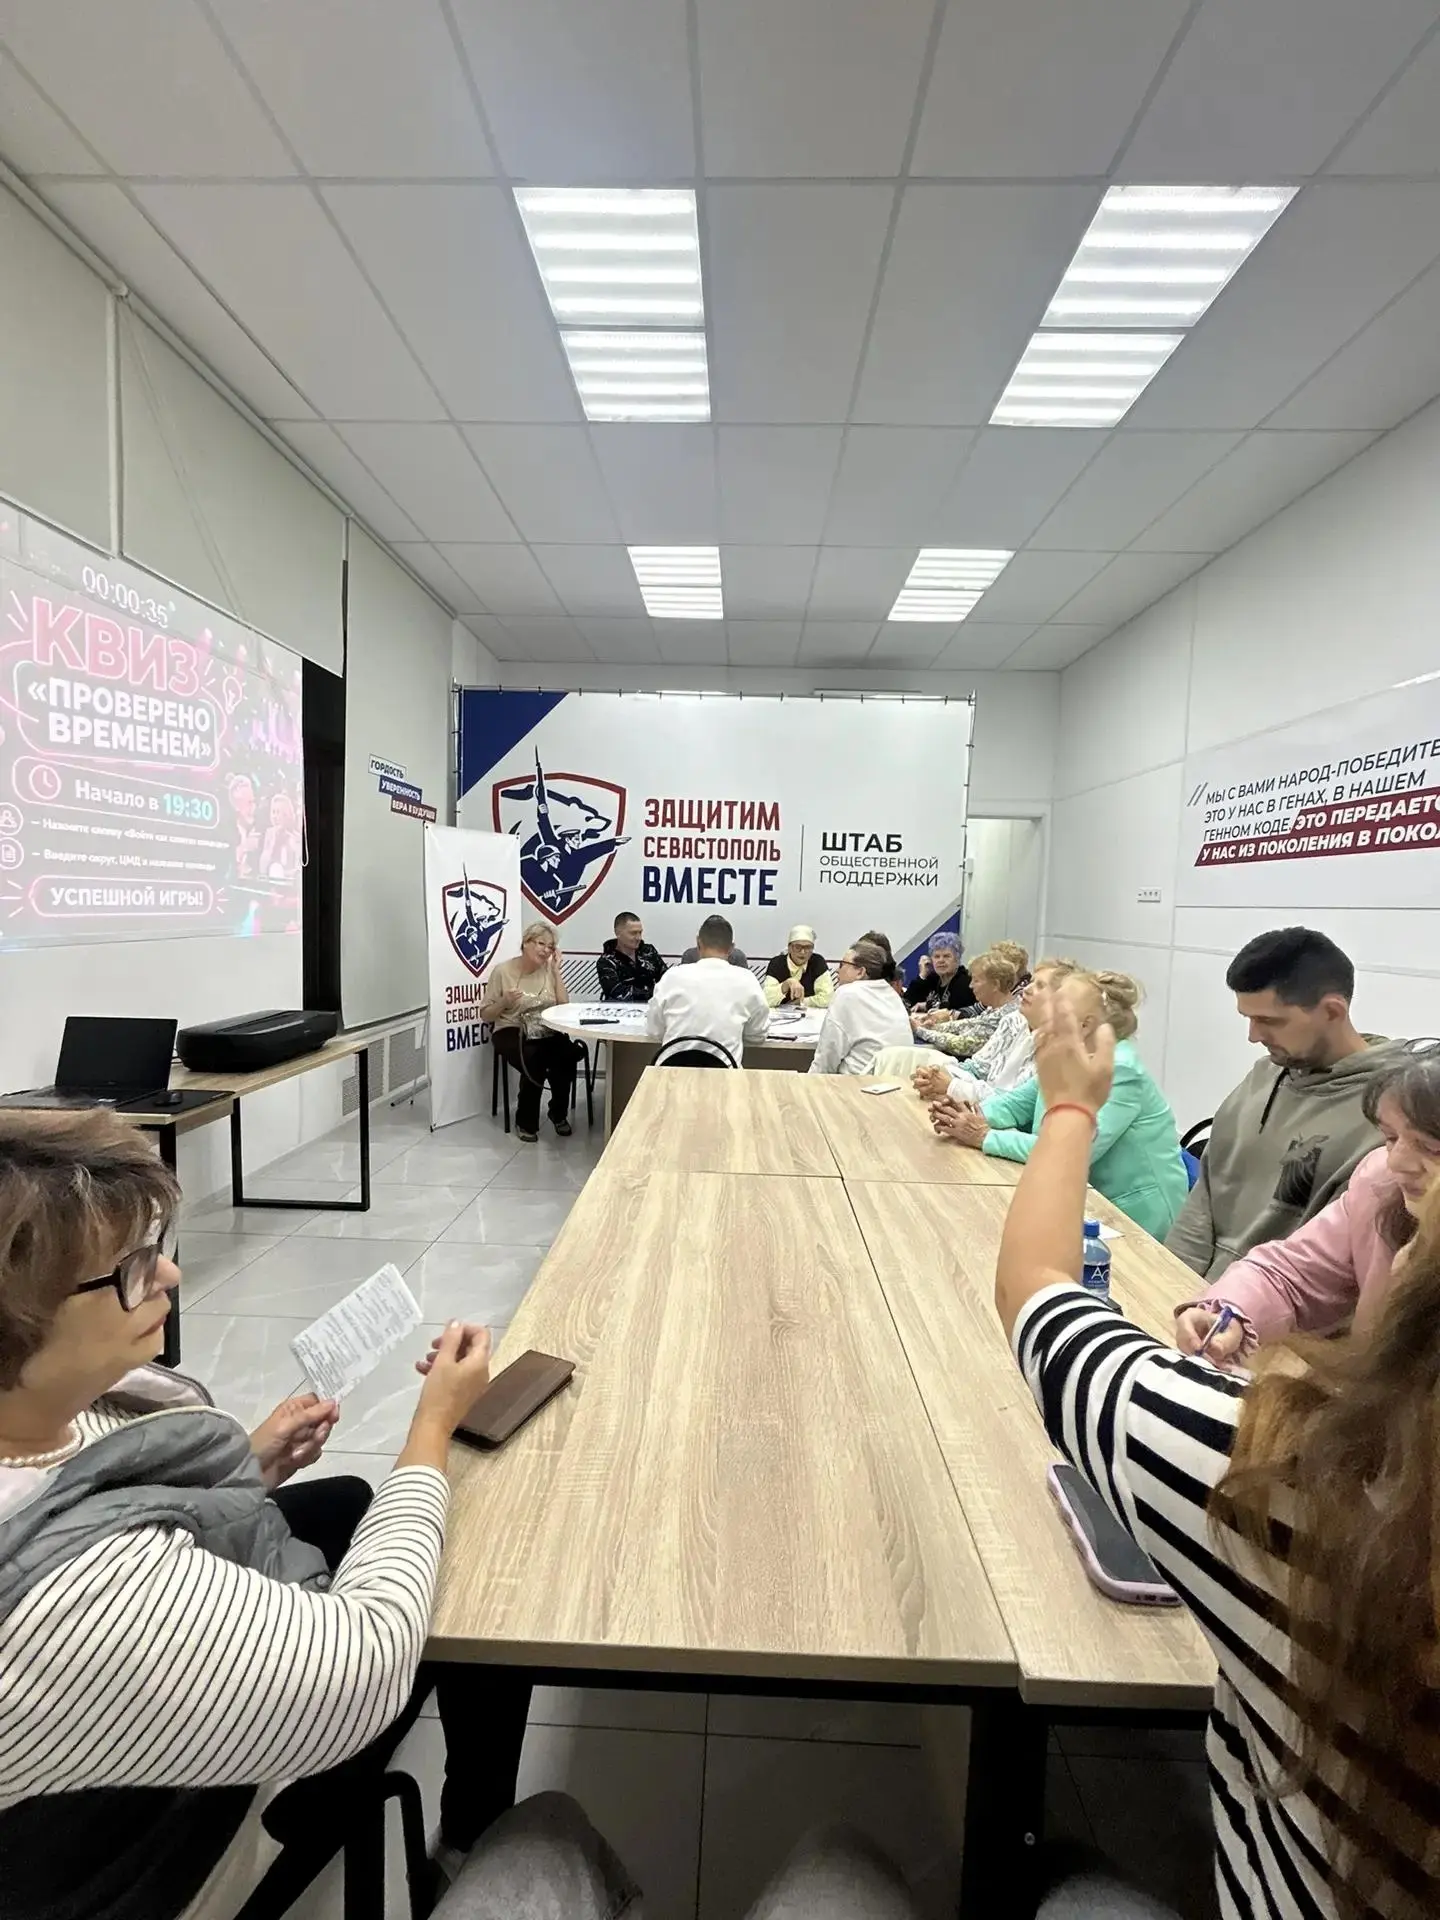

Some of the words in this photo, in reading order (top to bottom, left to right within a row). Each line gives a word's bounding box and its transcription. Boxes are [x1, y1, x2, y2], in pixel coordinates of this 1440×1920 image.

[33, 596, 199, 696] КВИЗ
[28, 677, 210, 731] «ПРОВЕРЕНО
[49, 712, 211, 759] ВРЕМЕНЕМ»
[370, 760, 404, 778] ГОРДОСТЬ
[1206, 789, 1226, 805] МЫ
[1227, 787, 1236, 800] С
[1238, 777, 1275, 798] ВАМИ
[1278, 739, 1440, 789] НАРОД-ПОБЕДИТЕ
[75, 779, 145, 809] Начало
[149, 797, 160, 810] в
[163, 793, 213, 821] 19:30
[392, 800, 408, 812] ВЕРА
[1204, 808, 1226, 823] ЭТО
[1227, 806, 1236, 820] У
[1238, 801, 1264, 818] НАС
[1267, 799, 1276, 813] В
[1279, 788, 1329, 811] ГЕНАХ,
[1333, 785, 1345, 802] В
[1349, 769, 1426, 799] НАШЕМ
[645, 798, 780, 833] ЗАЩИТИМ
[1203, 824, 1251, 843] ГЕННОМ
[1253, 817, 1292, 836] КОДЕ.
[1295, 811, 1327, 831] ЭТО
[643, 836, 781, 862] СЕВАСТОПОЛЬ
[821, 832, 903, 853] ШТАБ
[1202, 848, 1211, 861] У
[1211, 845, 1237, 860] НАС
[1238, 843, 1256, 857] ИЗ
[1258, 831, 1355, 856] ПОКОЛЕНИЯ
[1356, 830, 1371, 847] В
[819, 855, 939, 870] ОБЩЕСТВЕННОЙ
[642, 866, 778, 906] ВМЕСТЕ
[819, 870, 939, 887] ПОДДЕРЖКИ
[50, 886, 155, 906] УСПЕШНОЙ
[159, 891, 204, 906] ИГРЫ!
[445, 982, 489, 1005] ЗАЩИТ
[445, 1006, 482, 1024] СЕВАСТ
[446, 1022, 491, 1052] ВМЕС
